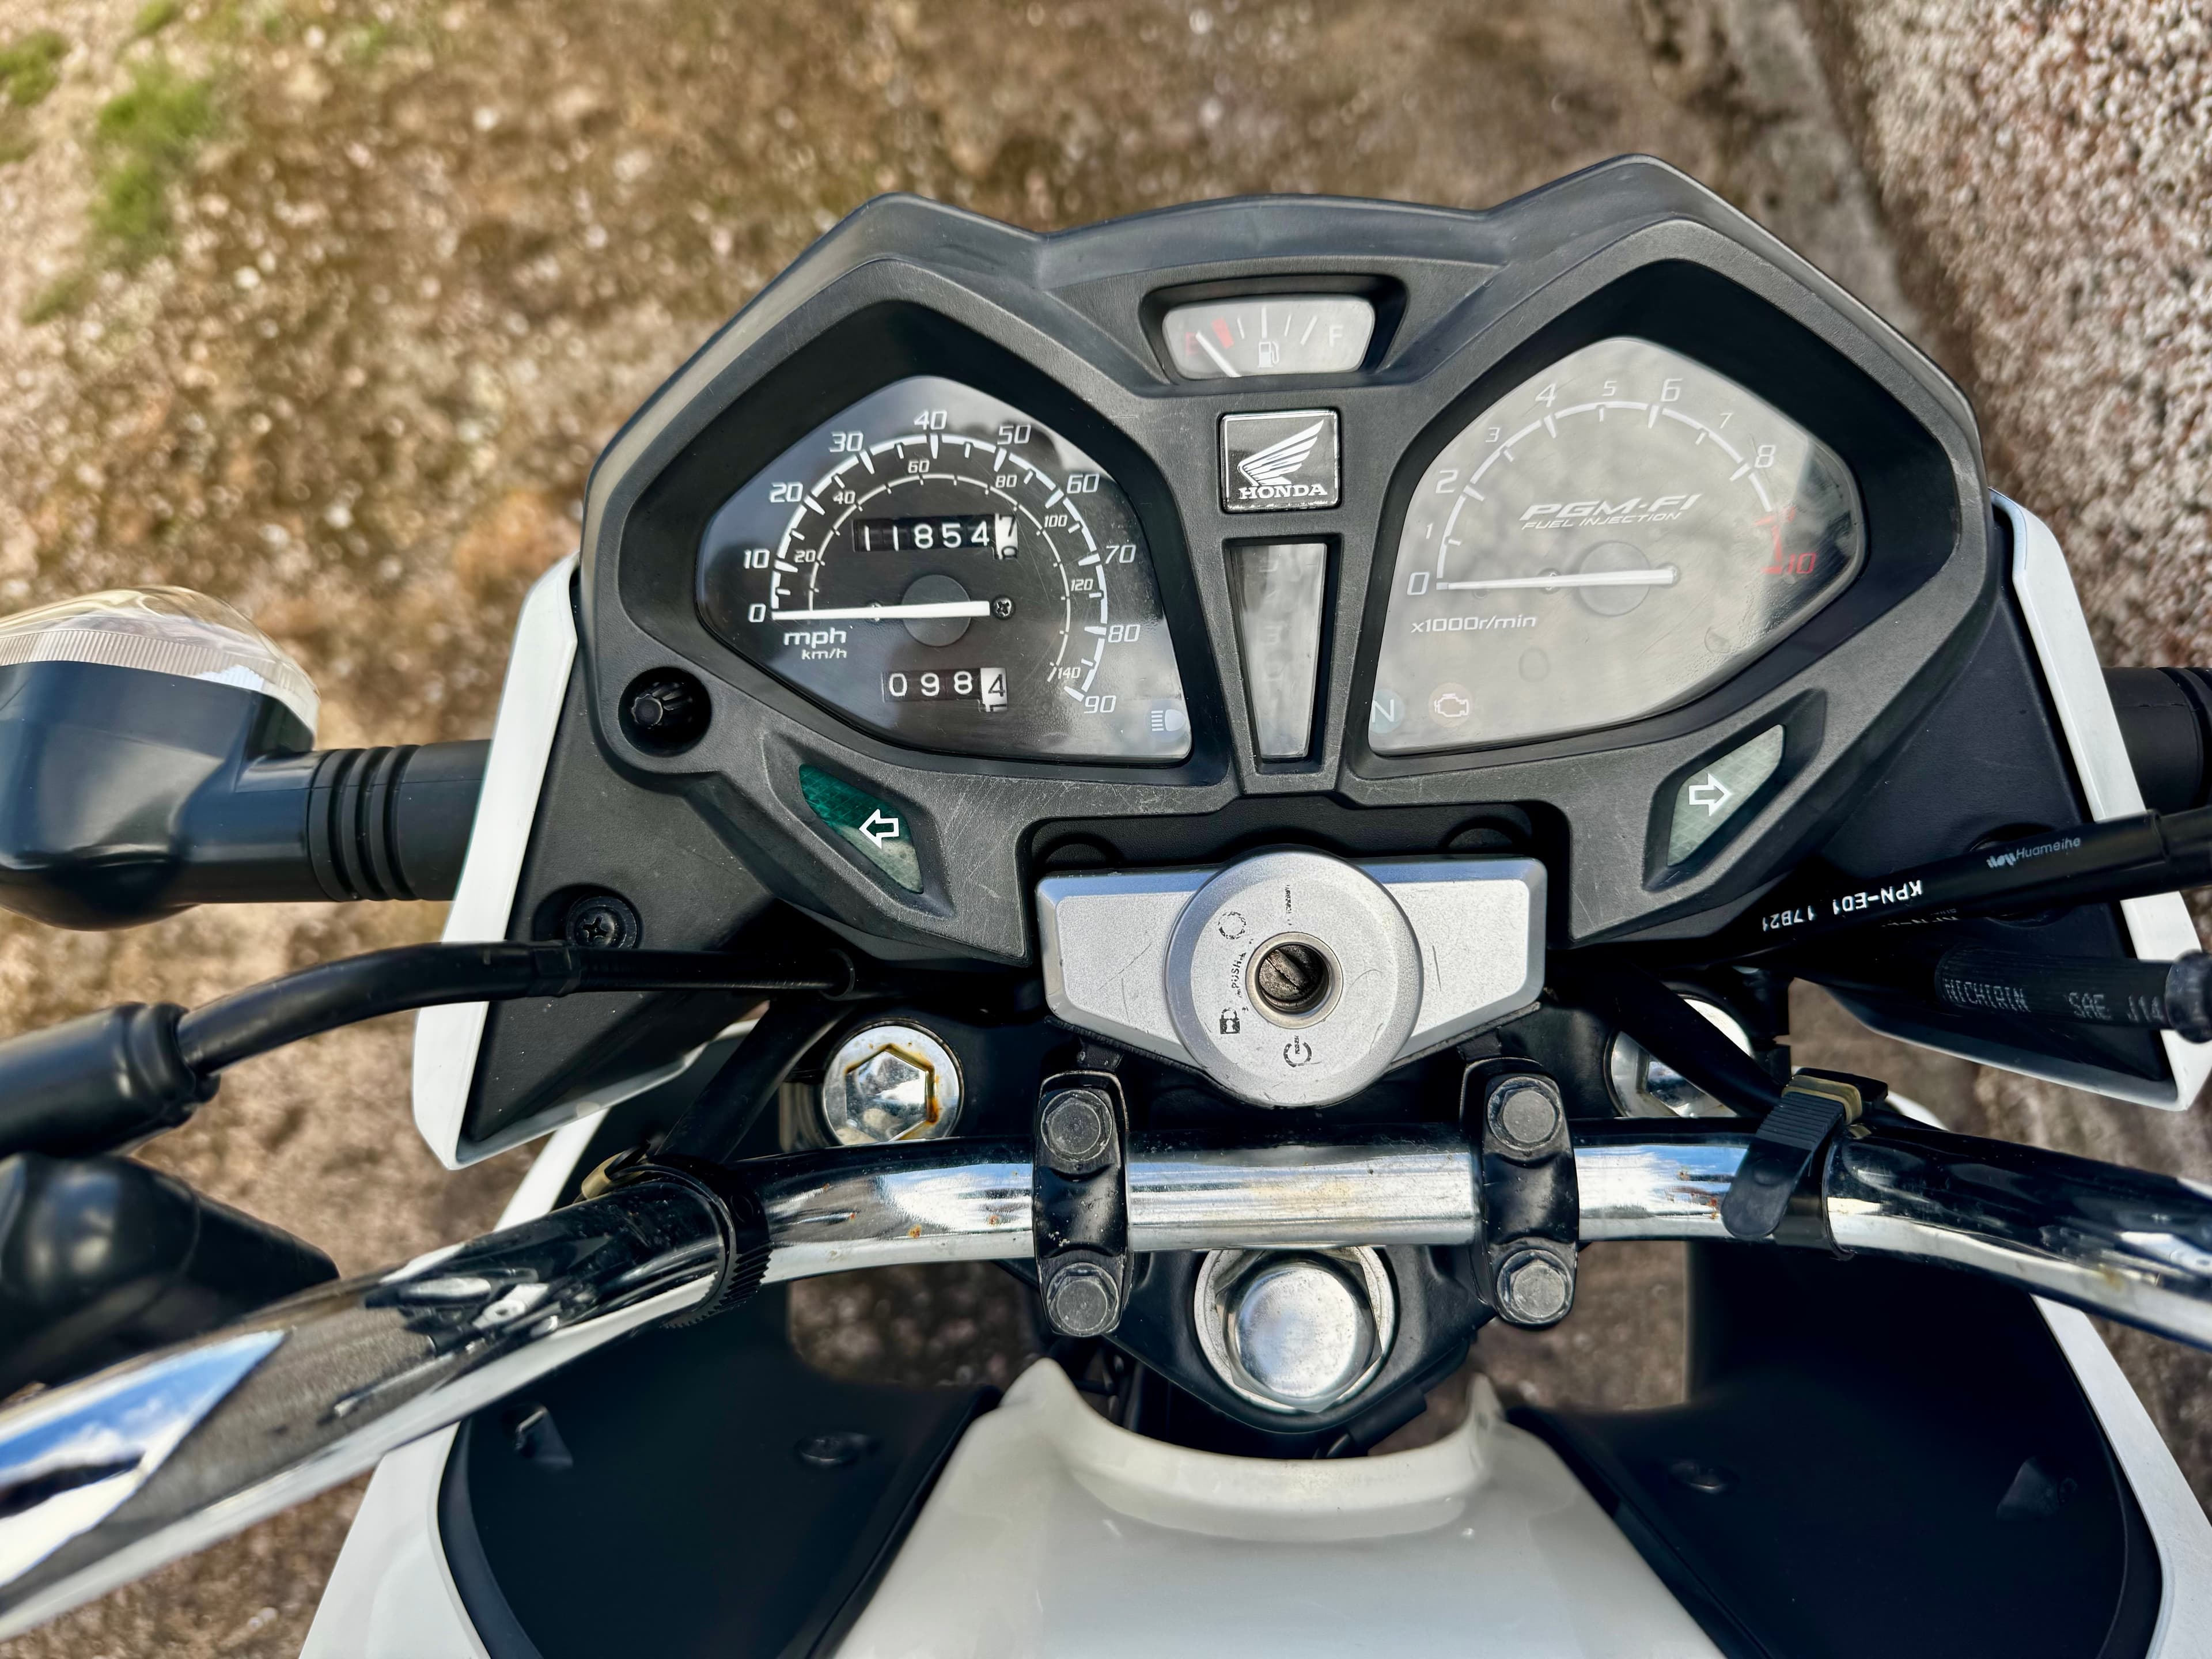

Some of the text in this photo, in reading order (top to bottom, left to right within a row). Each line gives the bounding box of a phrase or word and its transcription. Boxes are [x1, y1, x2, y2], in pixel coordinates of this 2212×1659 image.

[1328, 324, 1343, 346] F
[1535, 383, 1556, 407] 4
[1603, 381, 1616, 396] 5
[1661, 378, 1683, 402] 6
[914, 410, 948, 430] 40
[1720, 412, 1733, 428] 7
[830, 431, 863, 453] 30
[997, 424, 1031, 446] 50
[1486, 427, 1501, 442] 3
[1755, 445, 1777, 467] 8
[908, 460, 930, 474] 60
[995, 475, 1017, 488] 80
[1067, 474, 1100, 494] 60
[1238, 483, 1327, 500] HONDA
[1435, 471, 1459, 493] 2
[770, 482, 803, 503] 20
[833, 491, 856, 505] 40
[1520, 494, 1702, 521] PGM-FI
[1044, 514, 1068, 528] 100
[1521, 512, 1682, 531] FUEL INJECTION
[1426, 524, 1433, 539] 1
[744, 548, 768, 570] 10
[794, 550, 815, 563] 20
[1106, 544, 1136, 564] 70
[1788, 553, 1816, 574] 10
[1071, 578, 1093, 592] 120
[1407, 571, 1429, 595] 0
[748, 604, 766, 623] 0
[1411, 614, 1537, 632] x1000r/min
[783, 627, 847, 649] mph
[1108, 624, 1141, 642] 80
[801, 648, 847, 660] km/h
[1058, 667, 1081, 679] 140
[1084, 695, 1116, 714] 90
[1372, 699, 1395, 723] N
[2016, 837, 2081, 859] Huameihe
[1762, 905, 1816, 931] 17B21
[2068, 991, 2112, 1020] SAE
